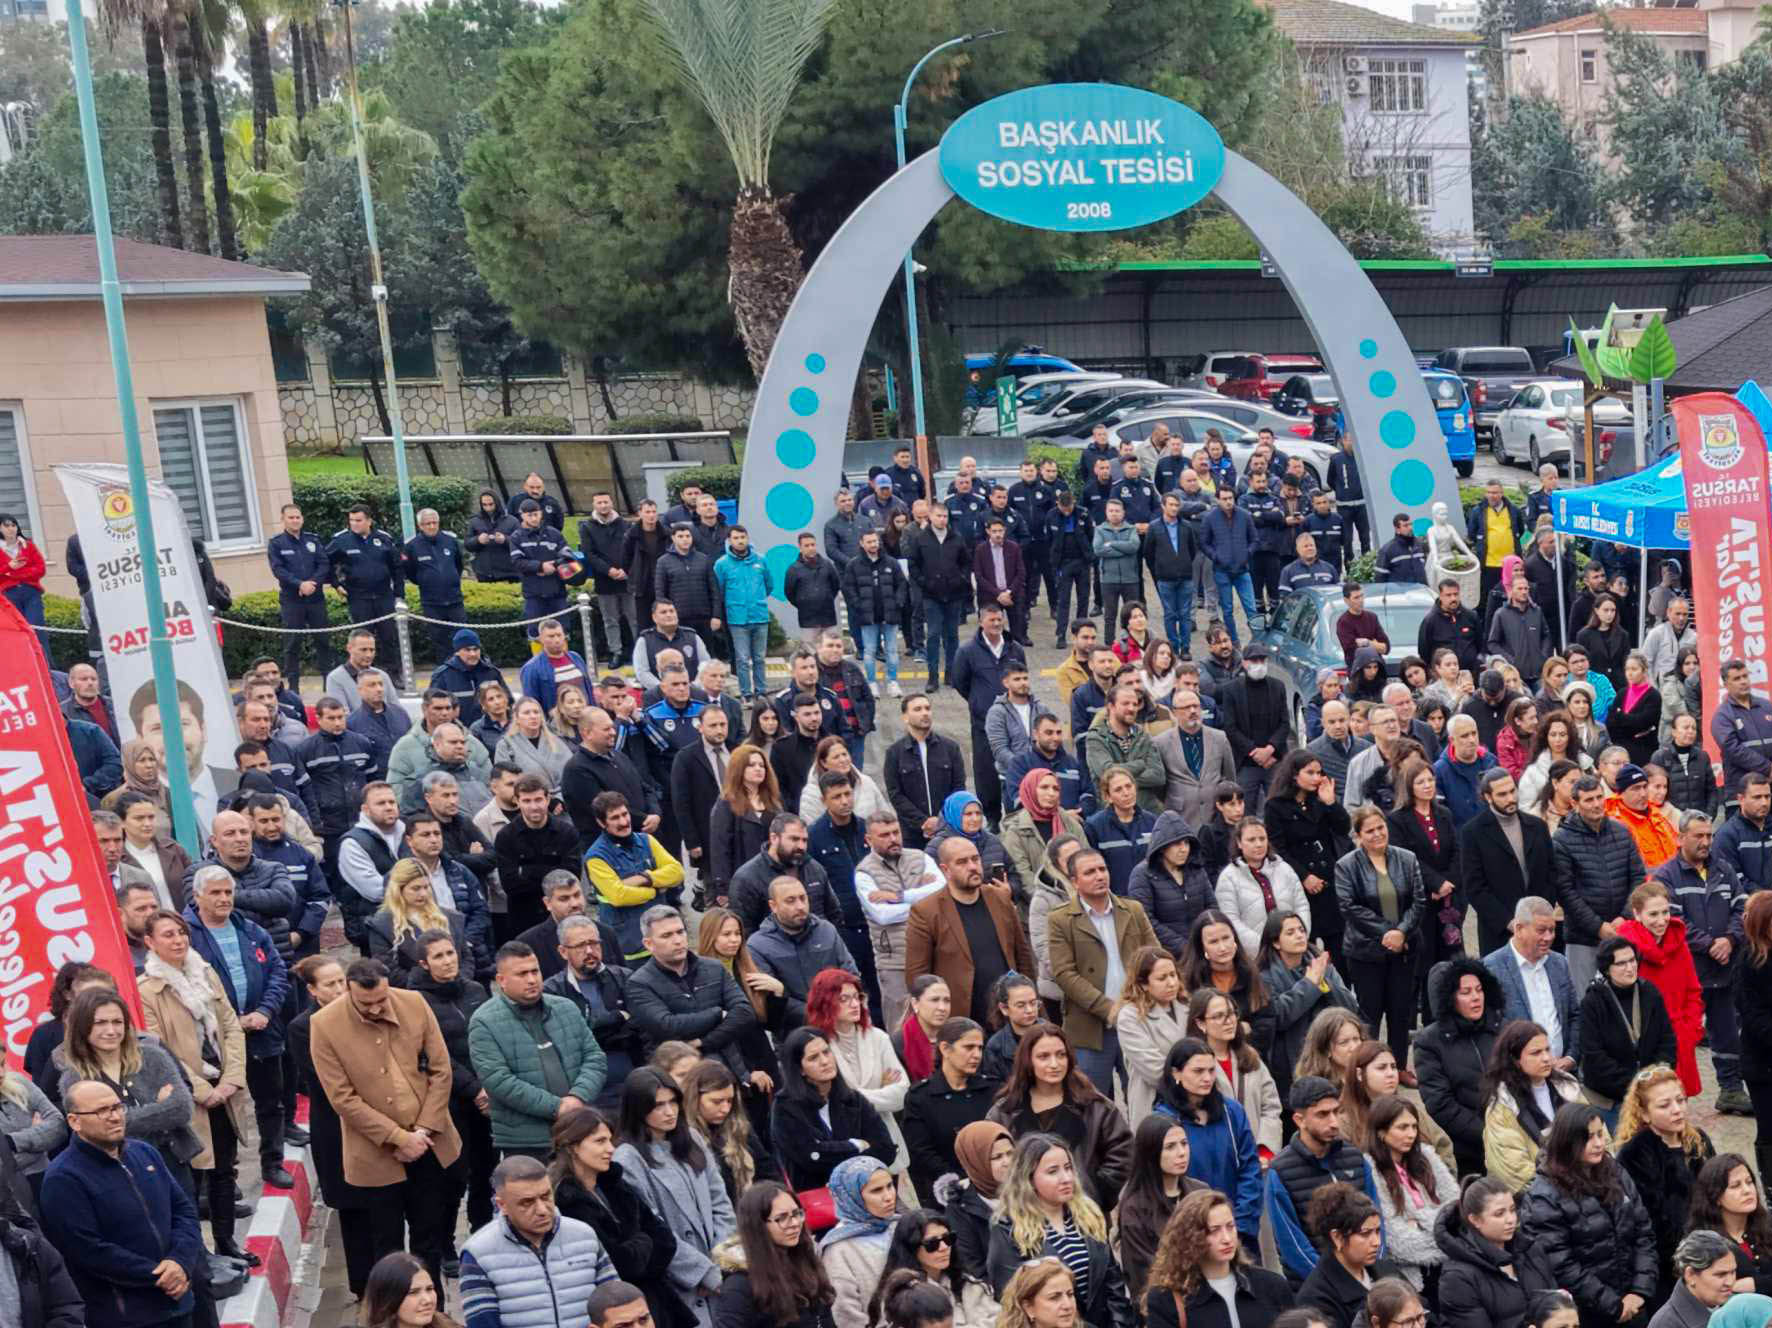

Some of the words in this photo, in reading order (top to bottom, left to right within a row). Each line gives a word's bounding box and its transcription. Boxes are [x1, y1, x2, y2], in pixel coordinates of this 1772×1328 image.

[999, 119, 1165, 154] BAŞKANLIK
[977, 157, 1095, 188] SOSYAL
[1100, 150, 1194, 184] TESİSİ
[1066, 201, 1112, 219] 2008
